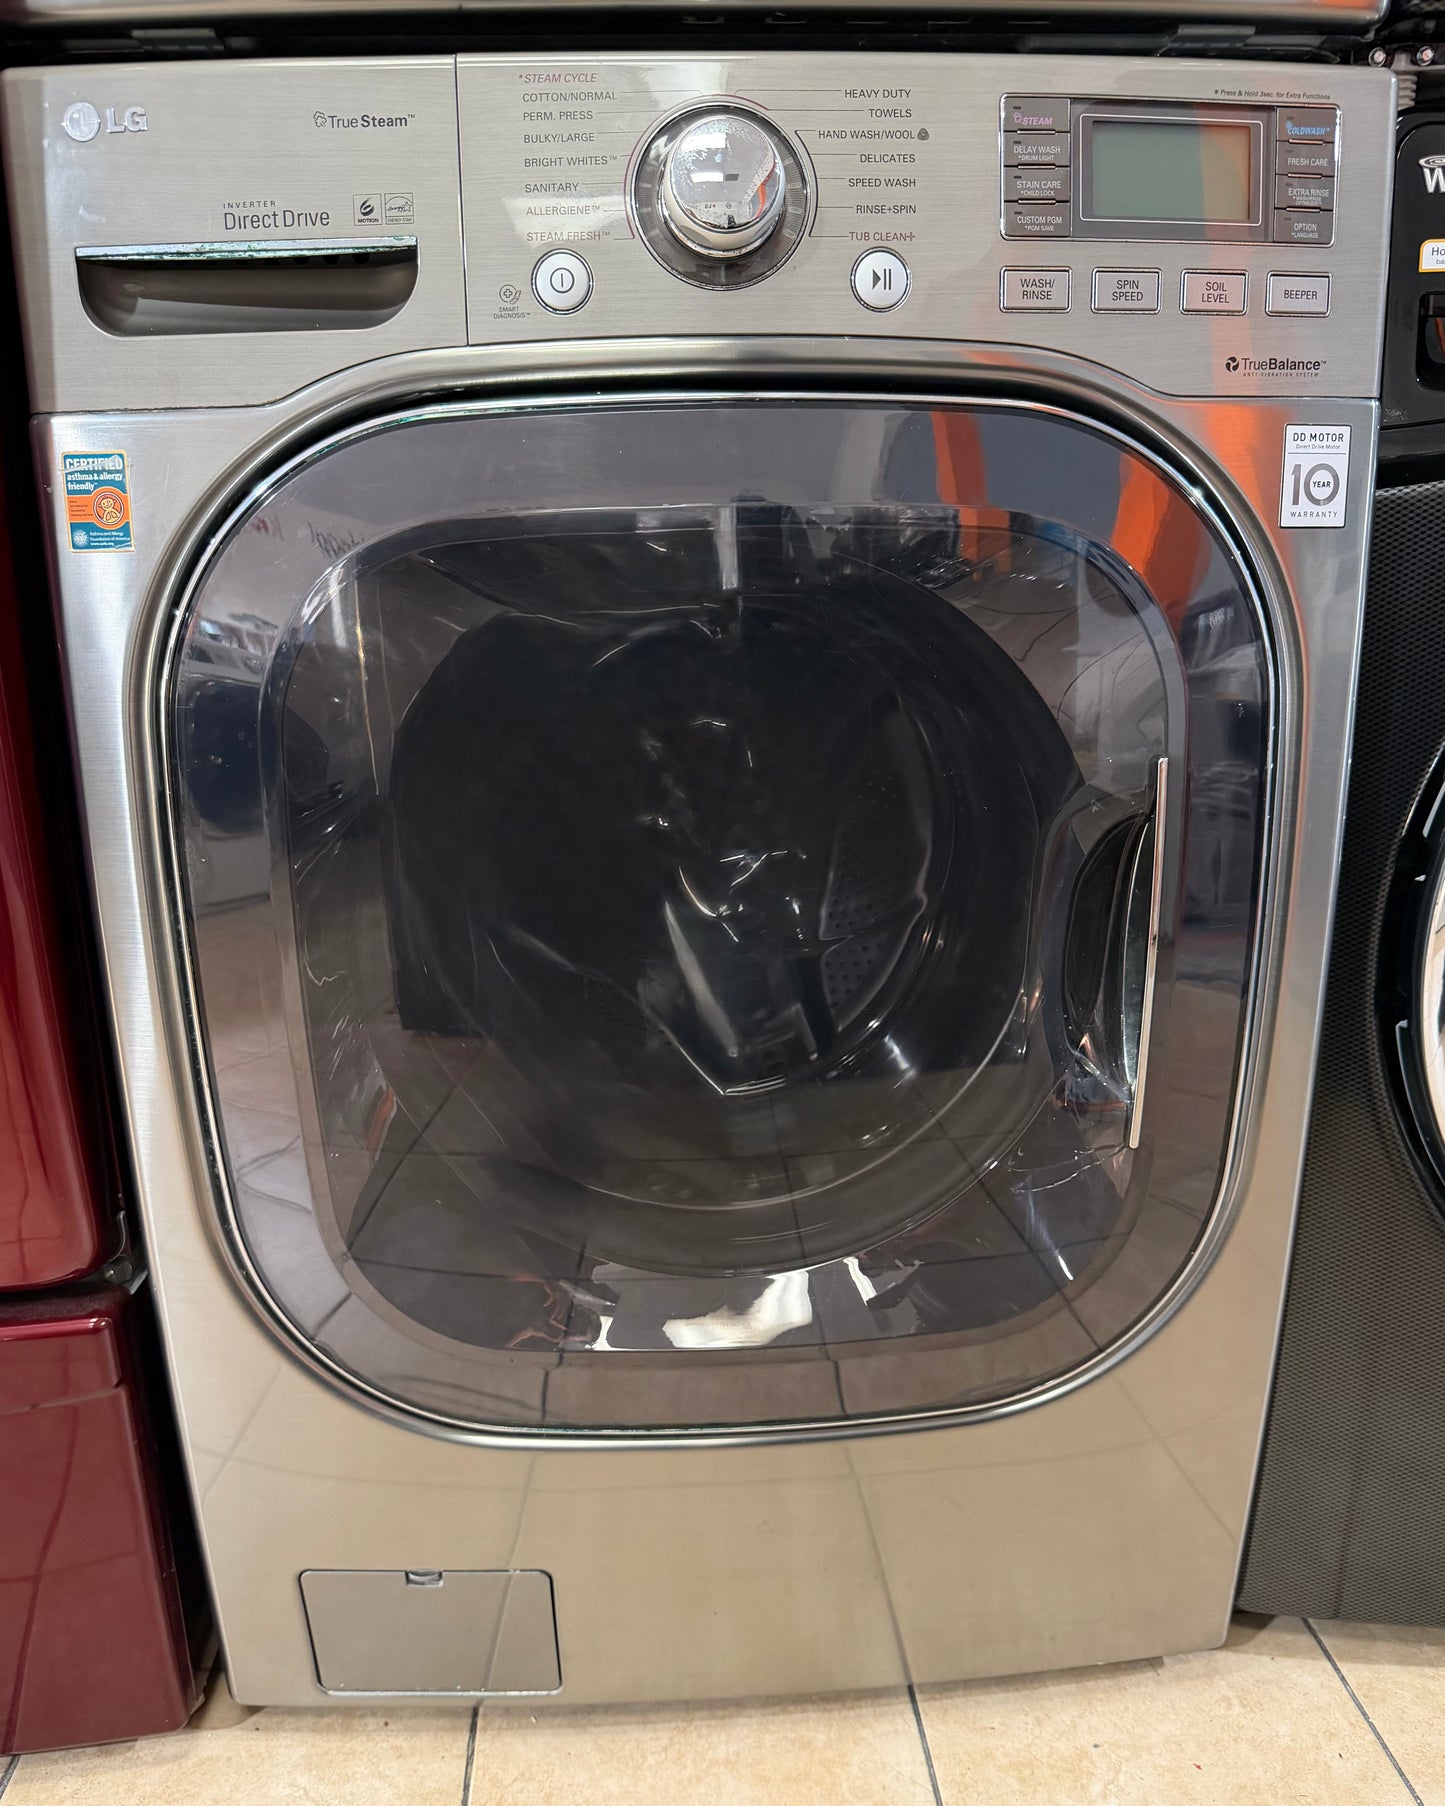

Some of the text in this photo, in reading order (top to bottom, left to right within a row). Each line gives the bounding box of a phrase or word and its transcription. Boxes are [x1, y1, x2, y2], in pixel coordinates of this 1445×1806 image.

[564, 73, 597, 83] CYCLE
[522, 91, 618, 102] COTTON/NORMAL
[844, 89, 912, 98] HEAVY DUTY
[1302, 92, 1330, 100] Functions
[523, 110, 594, 120] PERM. PRESS
[868, 108, 912, 118] TOWELS
[105, 106, 148, 134] LG
[1022, 117, 1052, 125] STEAM
[524, 132, 595, 144] BULKY/LARGE
[818, 130, 915, 140] HAND WASH/WOOL
[1013, 146, 1061, 154] DELAY WASH
[524, 157, 564, 168] BRIGHT
[860, 154, 916, 163] DELICATES
[1288, 158, 1328, 166] FRESH CARE
[524, 182, 579, 193] SANITARY
[848, 178, 916, 188] SPEED WASH
[1016, 181, 1062, 189] STAIN CARE
[1288, 188, 1330, 197] EXTRA RINSE
[223, 200, 276, 209] INVERTER
[856, 204, 916, 214] RINSE+SPIN
[1016, 216, 1062, 224] CUSTOM PGM
[1294, 223, 1317, 231] OPTION
[526, 232, 564, 242] STEAM
[848, 231, 870, 241] TUB
[1020, 278, 1055, 288] WASH/
[1116, 280, 1140, 290] SPIN
[1205, 282, 1227, 292] SOIL
[1022, 290, 1052, 300] RINSE
[1112, 292, 1144, 301] SPEED
[1202, 293, 1230, 303] LEVEL
[1284, 289, 1318, 300] BEEPER
[1293, 432, 1344, 442] DD MOTOR
[66, 456, 123, 470] CERTIFIED
[67, 472, 93, 480] asthma
[99, 472, 123, 482] allergy
[1292, 463, 1340, 506] 10
